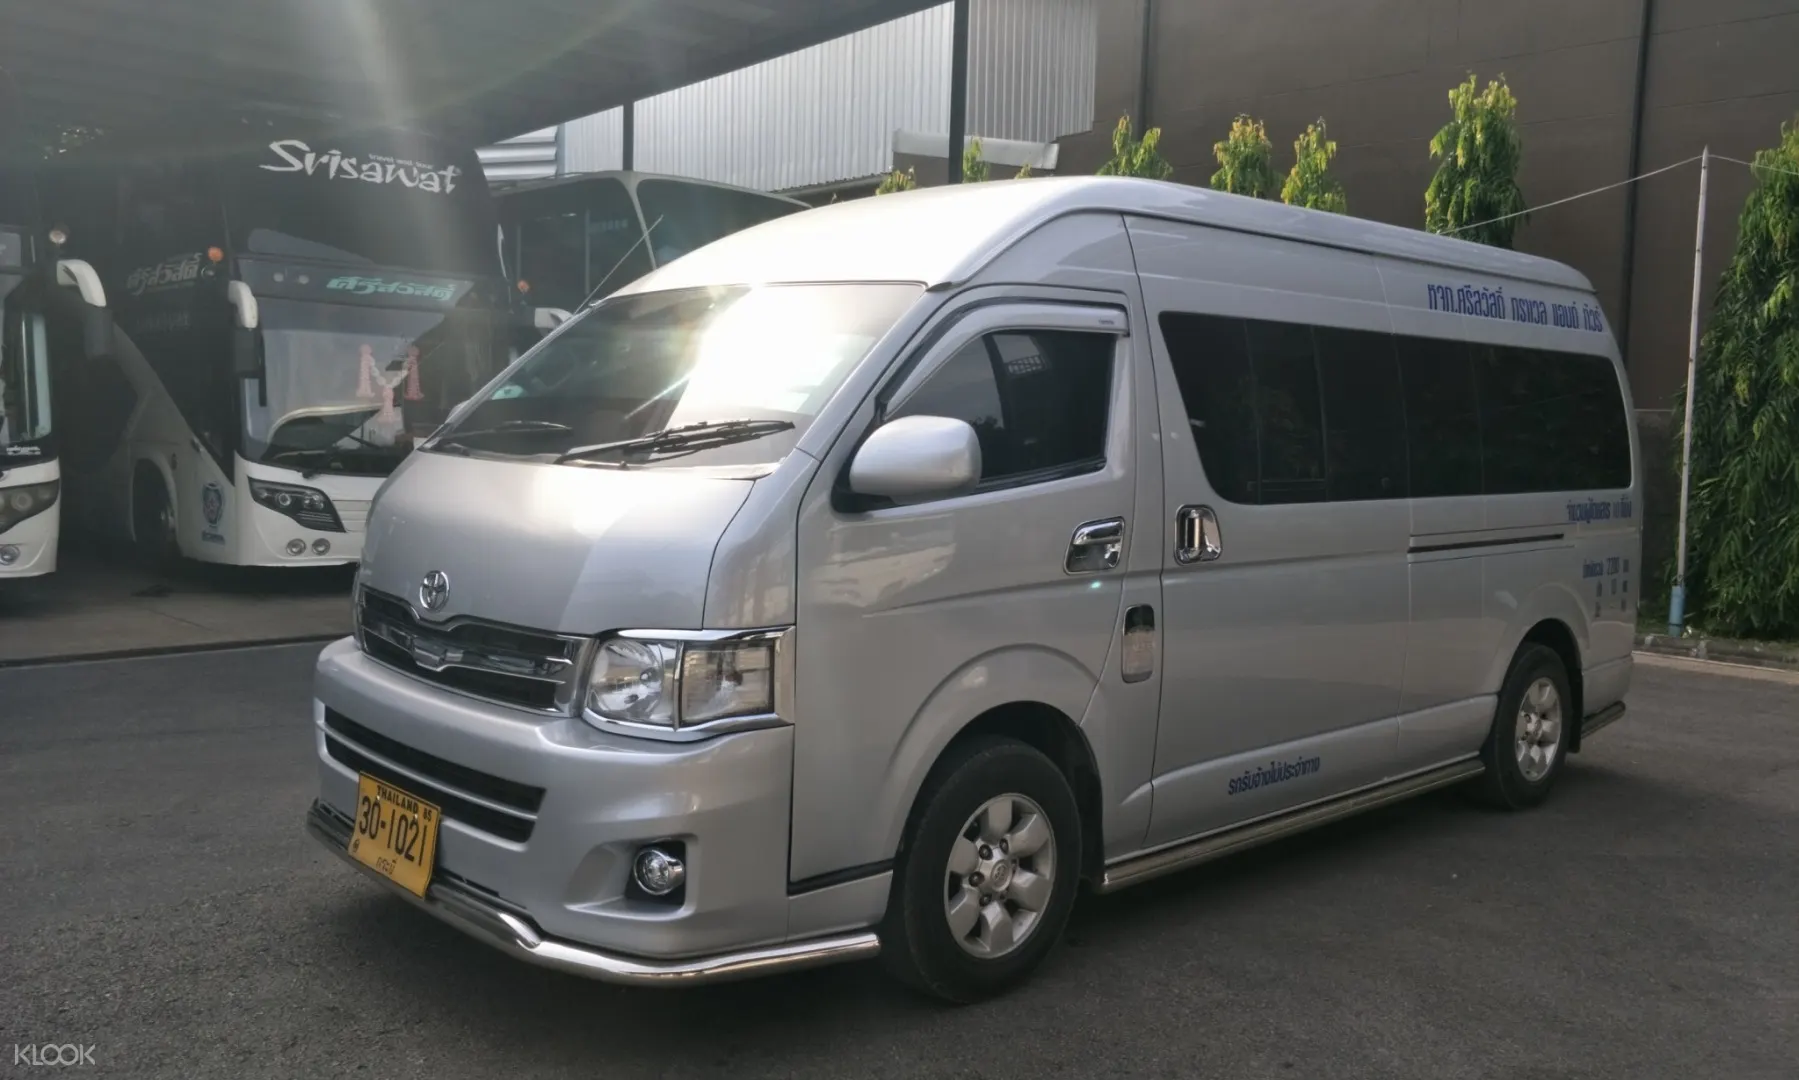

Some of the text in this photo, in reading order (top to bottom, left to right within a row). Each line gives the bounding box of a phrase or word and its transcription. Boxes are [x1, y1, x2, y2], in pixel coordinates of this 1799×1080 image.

[258, 139, 458, 194] Srisawat
[1551, 300, 1580, 330] แอนด์
[1582, 303, 1604, 333] ทัวร์
[377, 785, 419, 814] THAILAND
[359, 795, 428, 867] 30-1021
